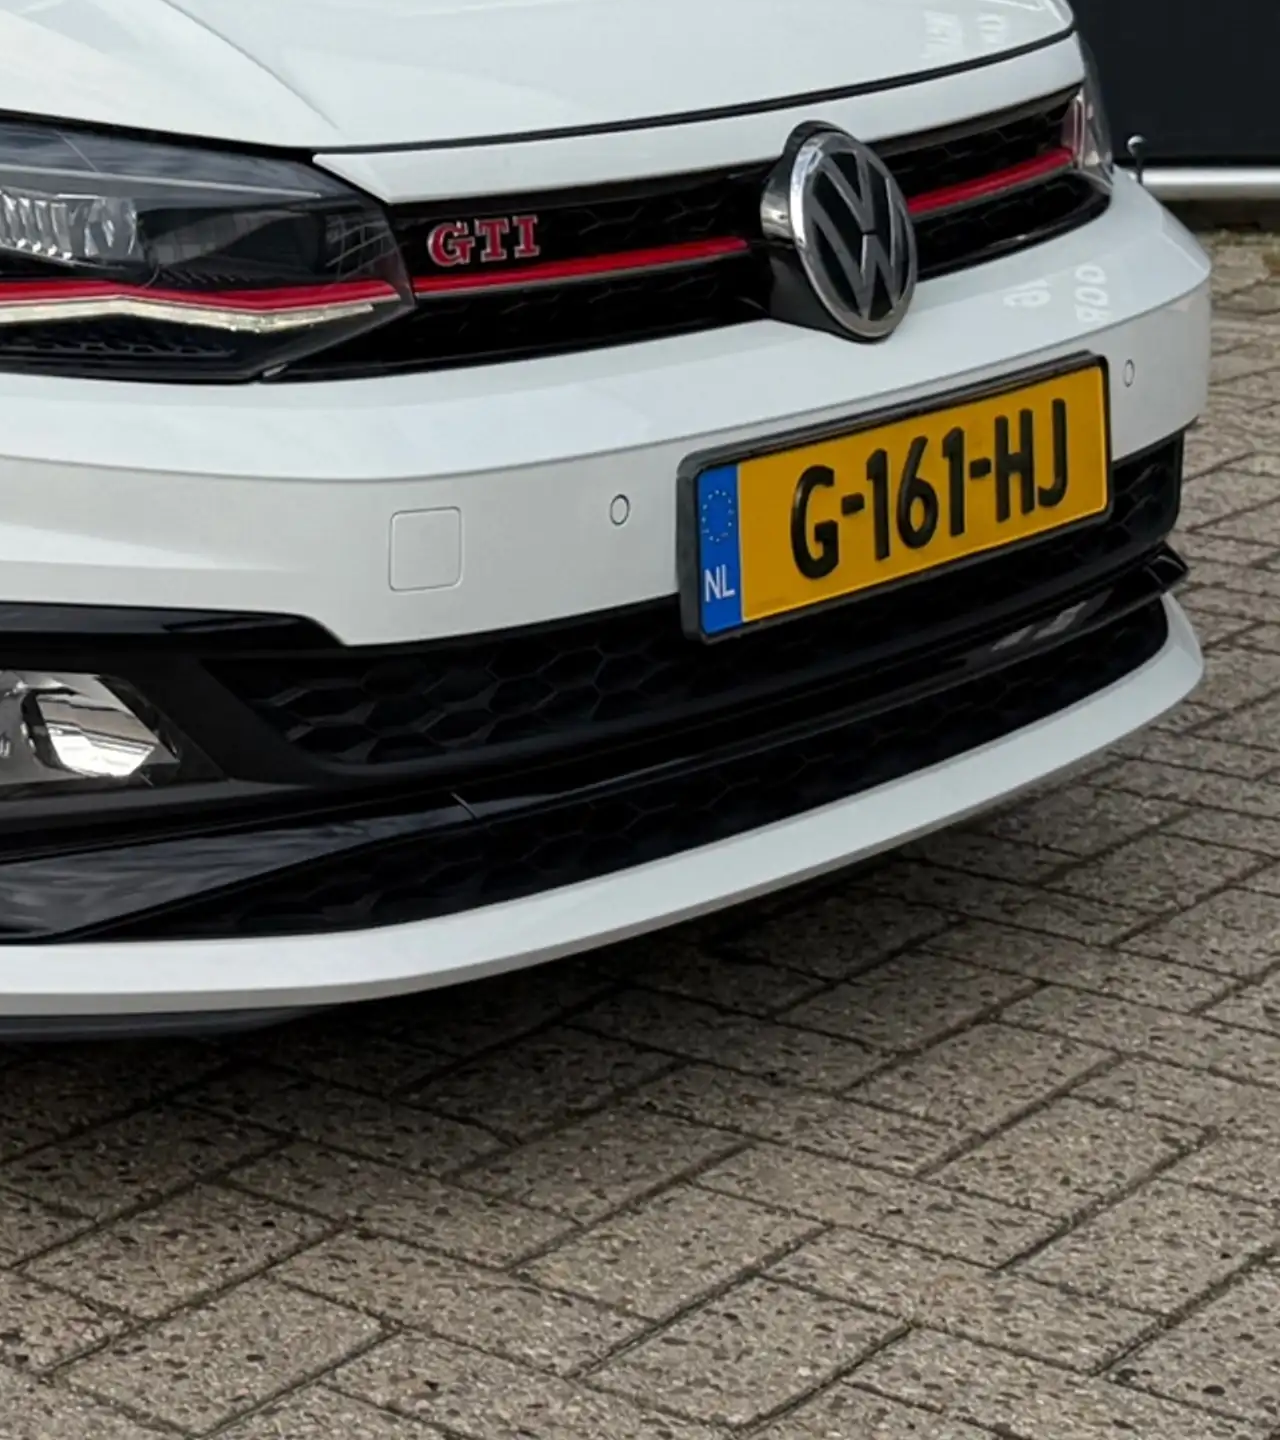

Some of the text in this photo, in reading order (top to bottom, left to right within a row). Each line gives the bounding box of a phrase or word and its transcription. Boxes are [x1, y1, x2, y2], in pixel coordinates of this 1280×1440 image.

[427, 214, 540, 267] GTI
[790, 398, 1067, 579] G-161-HJ
[704, 563, 736, 602] NL
